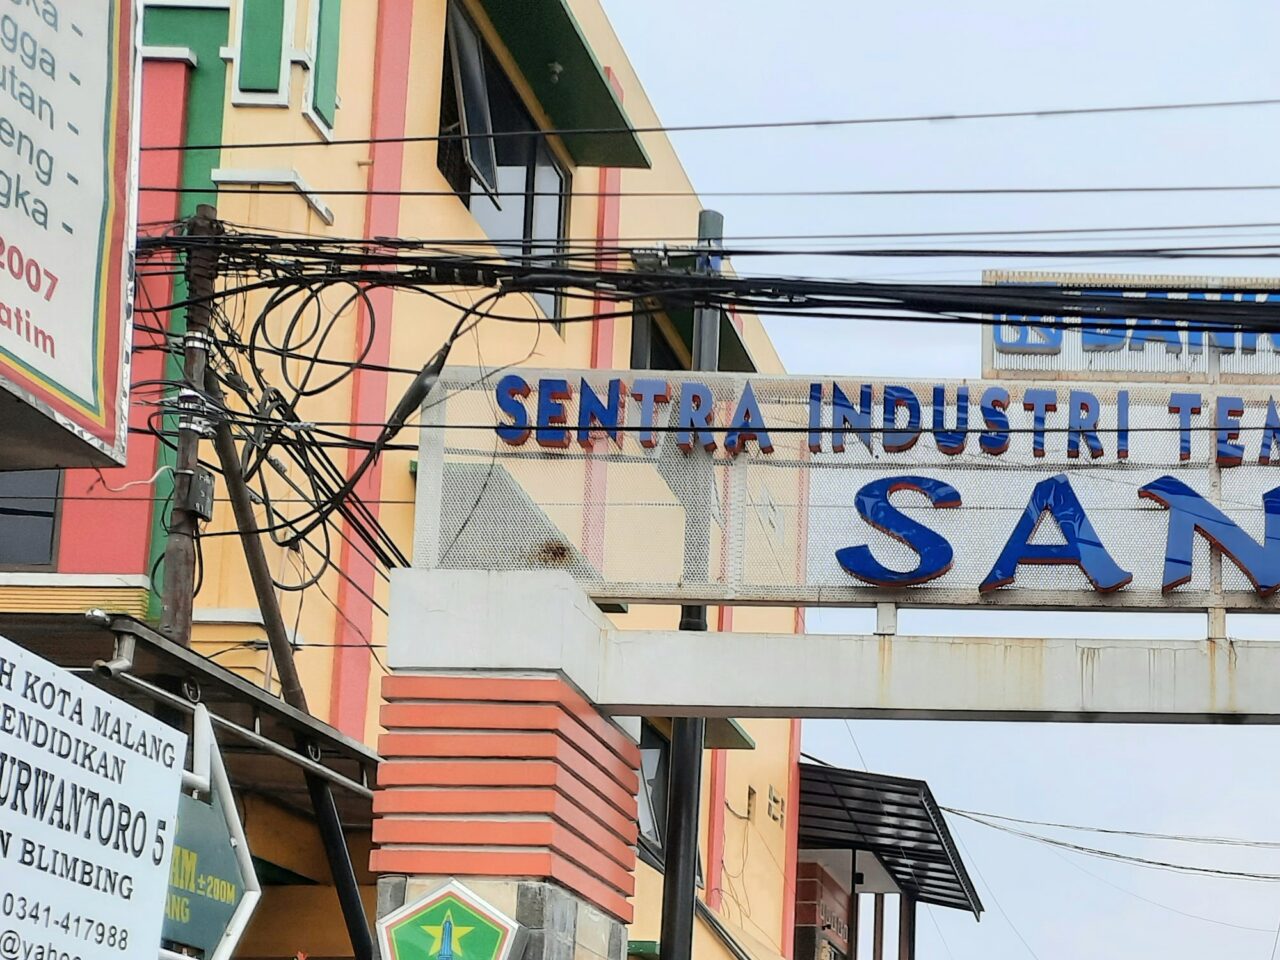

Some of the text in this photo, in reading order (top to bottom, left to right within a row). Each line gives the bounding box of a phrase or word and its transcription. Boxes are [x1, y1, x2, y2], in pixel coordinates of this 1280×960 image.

[495, 374, 773, 455] SENTRA
[808, 381, 1130, 459] INDUSTRI
[0, 703, 127, 785] ENDIDIKAN
[21, 669, 84, 722] KOTA
[91, 705, 176, 768] MALANG
[19, 837, 134, 901] BLIMBING
[152, 819, 167, 866] 5
[2, 891, 129, 950] 0341-417988
